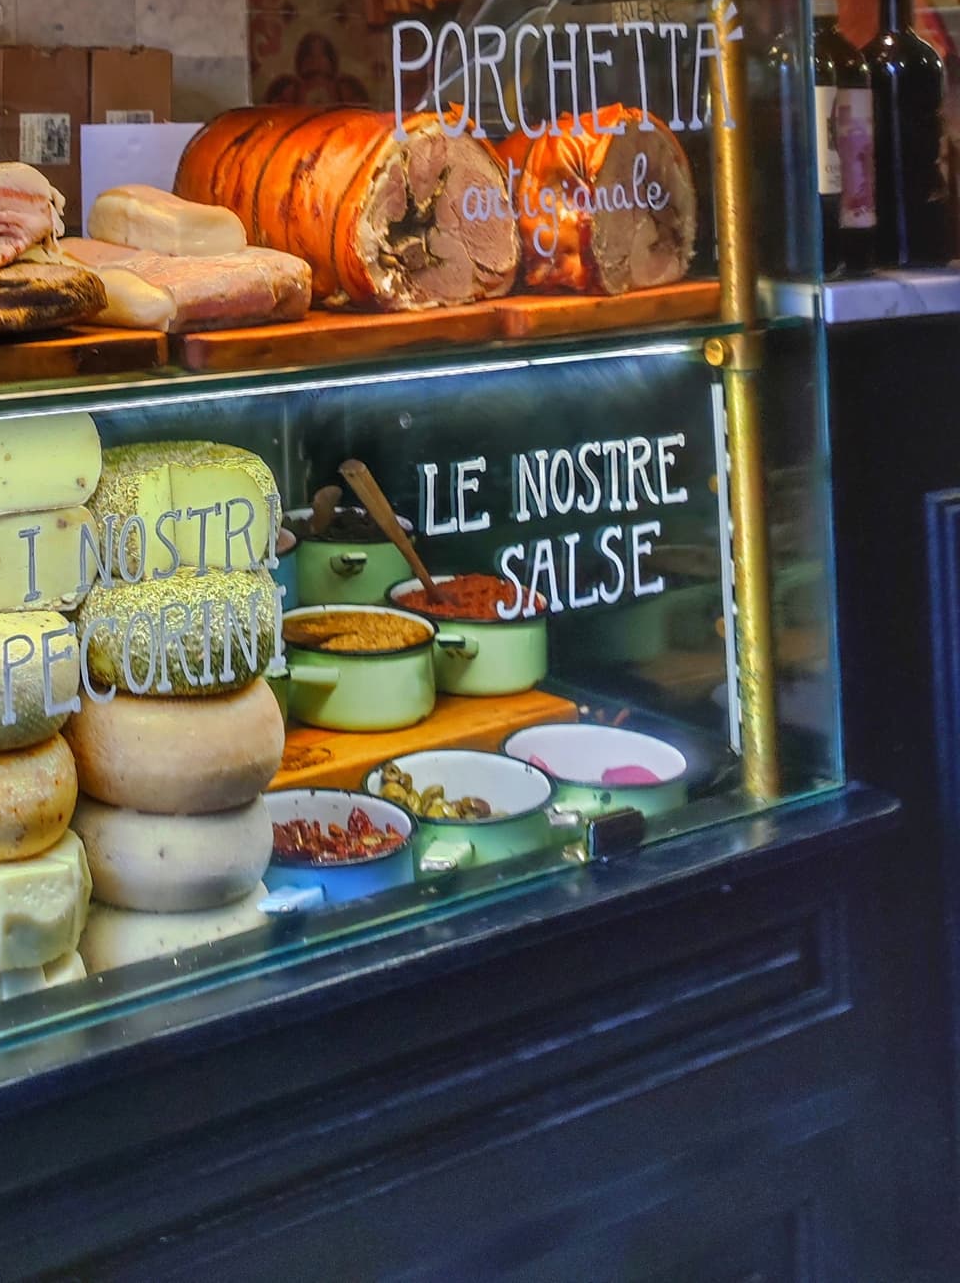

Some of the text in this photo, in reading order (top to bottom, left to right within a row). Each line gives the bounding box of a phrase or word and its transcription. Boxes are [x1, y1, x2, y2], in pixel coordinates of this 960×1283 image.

[392, 19, 737, 142] PORCHETTA
[461, 152, 670, 258] artigianale
[423, 432, 688, 537] LE NOSTRE
[17, 492, 281, 603] I NOSTRI
[496, 520, 665, 621] SALSE
[1, 584, 290, 727] PECORINI
